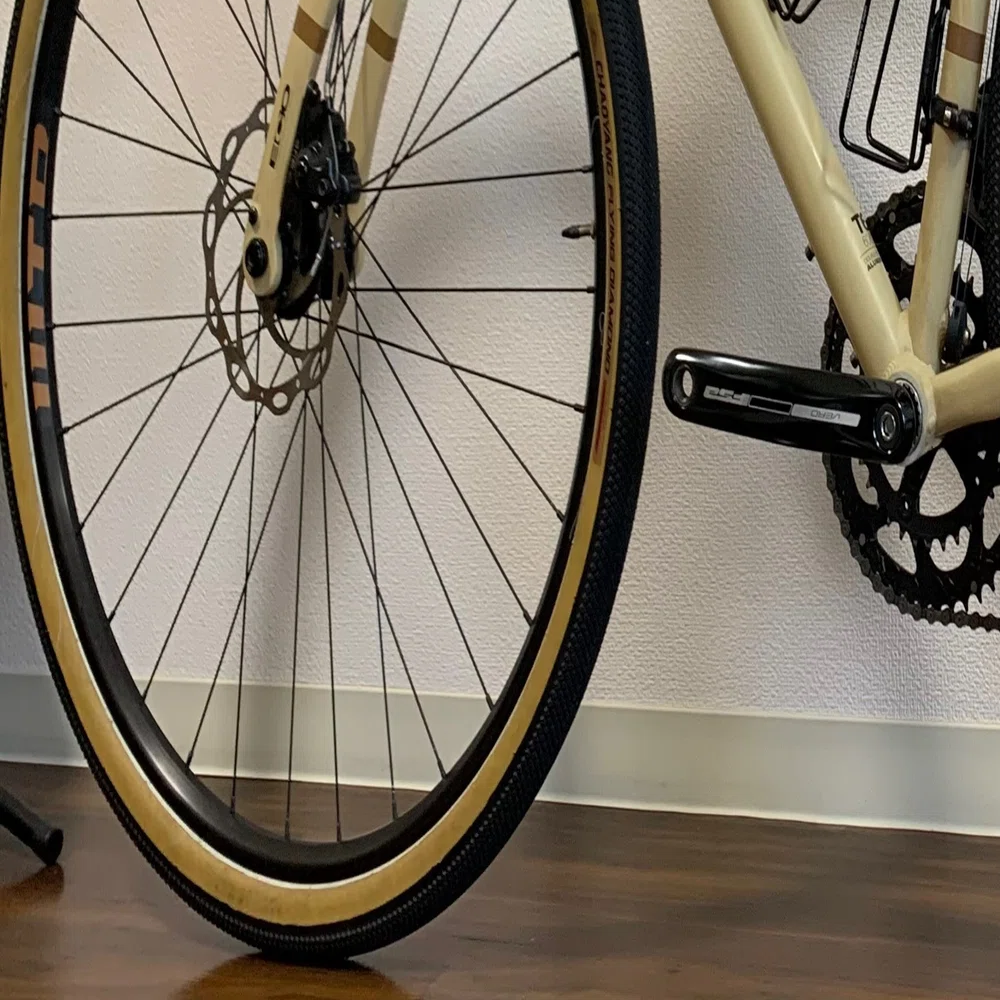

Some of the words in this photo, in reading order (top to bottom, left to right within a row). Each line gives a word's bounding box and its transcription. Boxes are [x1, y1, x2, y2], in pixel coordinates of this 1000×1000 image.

[595, 60, 614, 177] CHAOYANG
[604, 269, 616, 375] DIAMOND
[810, 408, 841, 421] VERO
